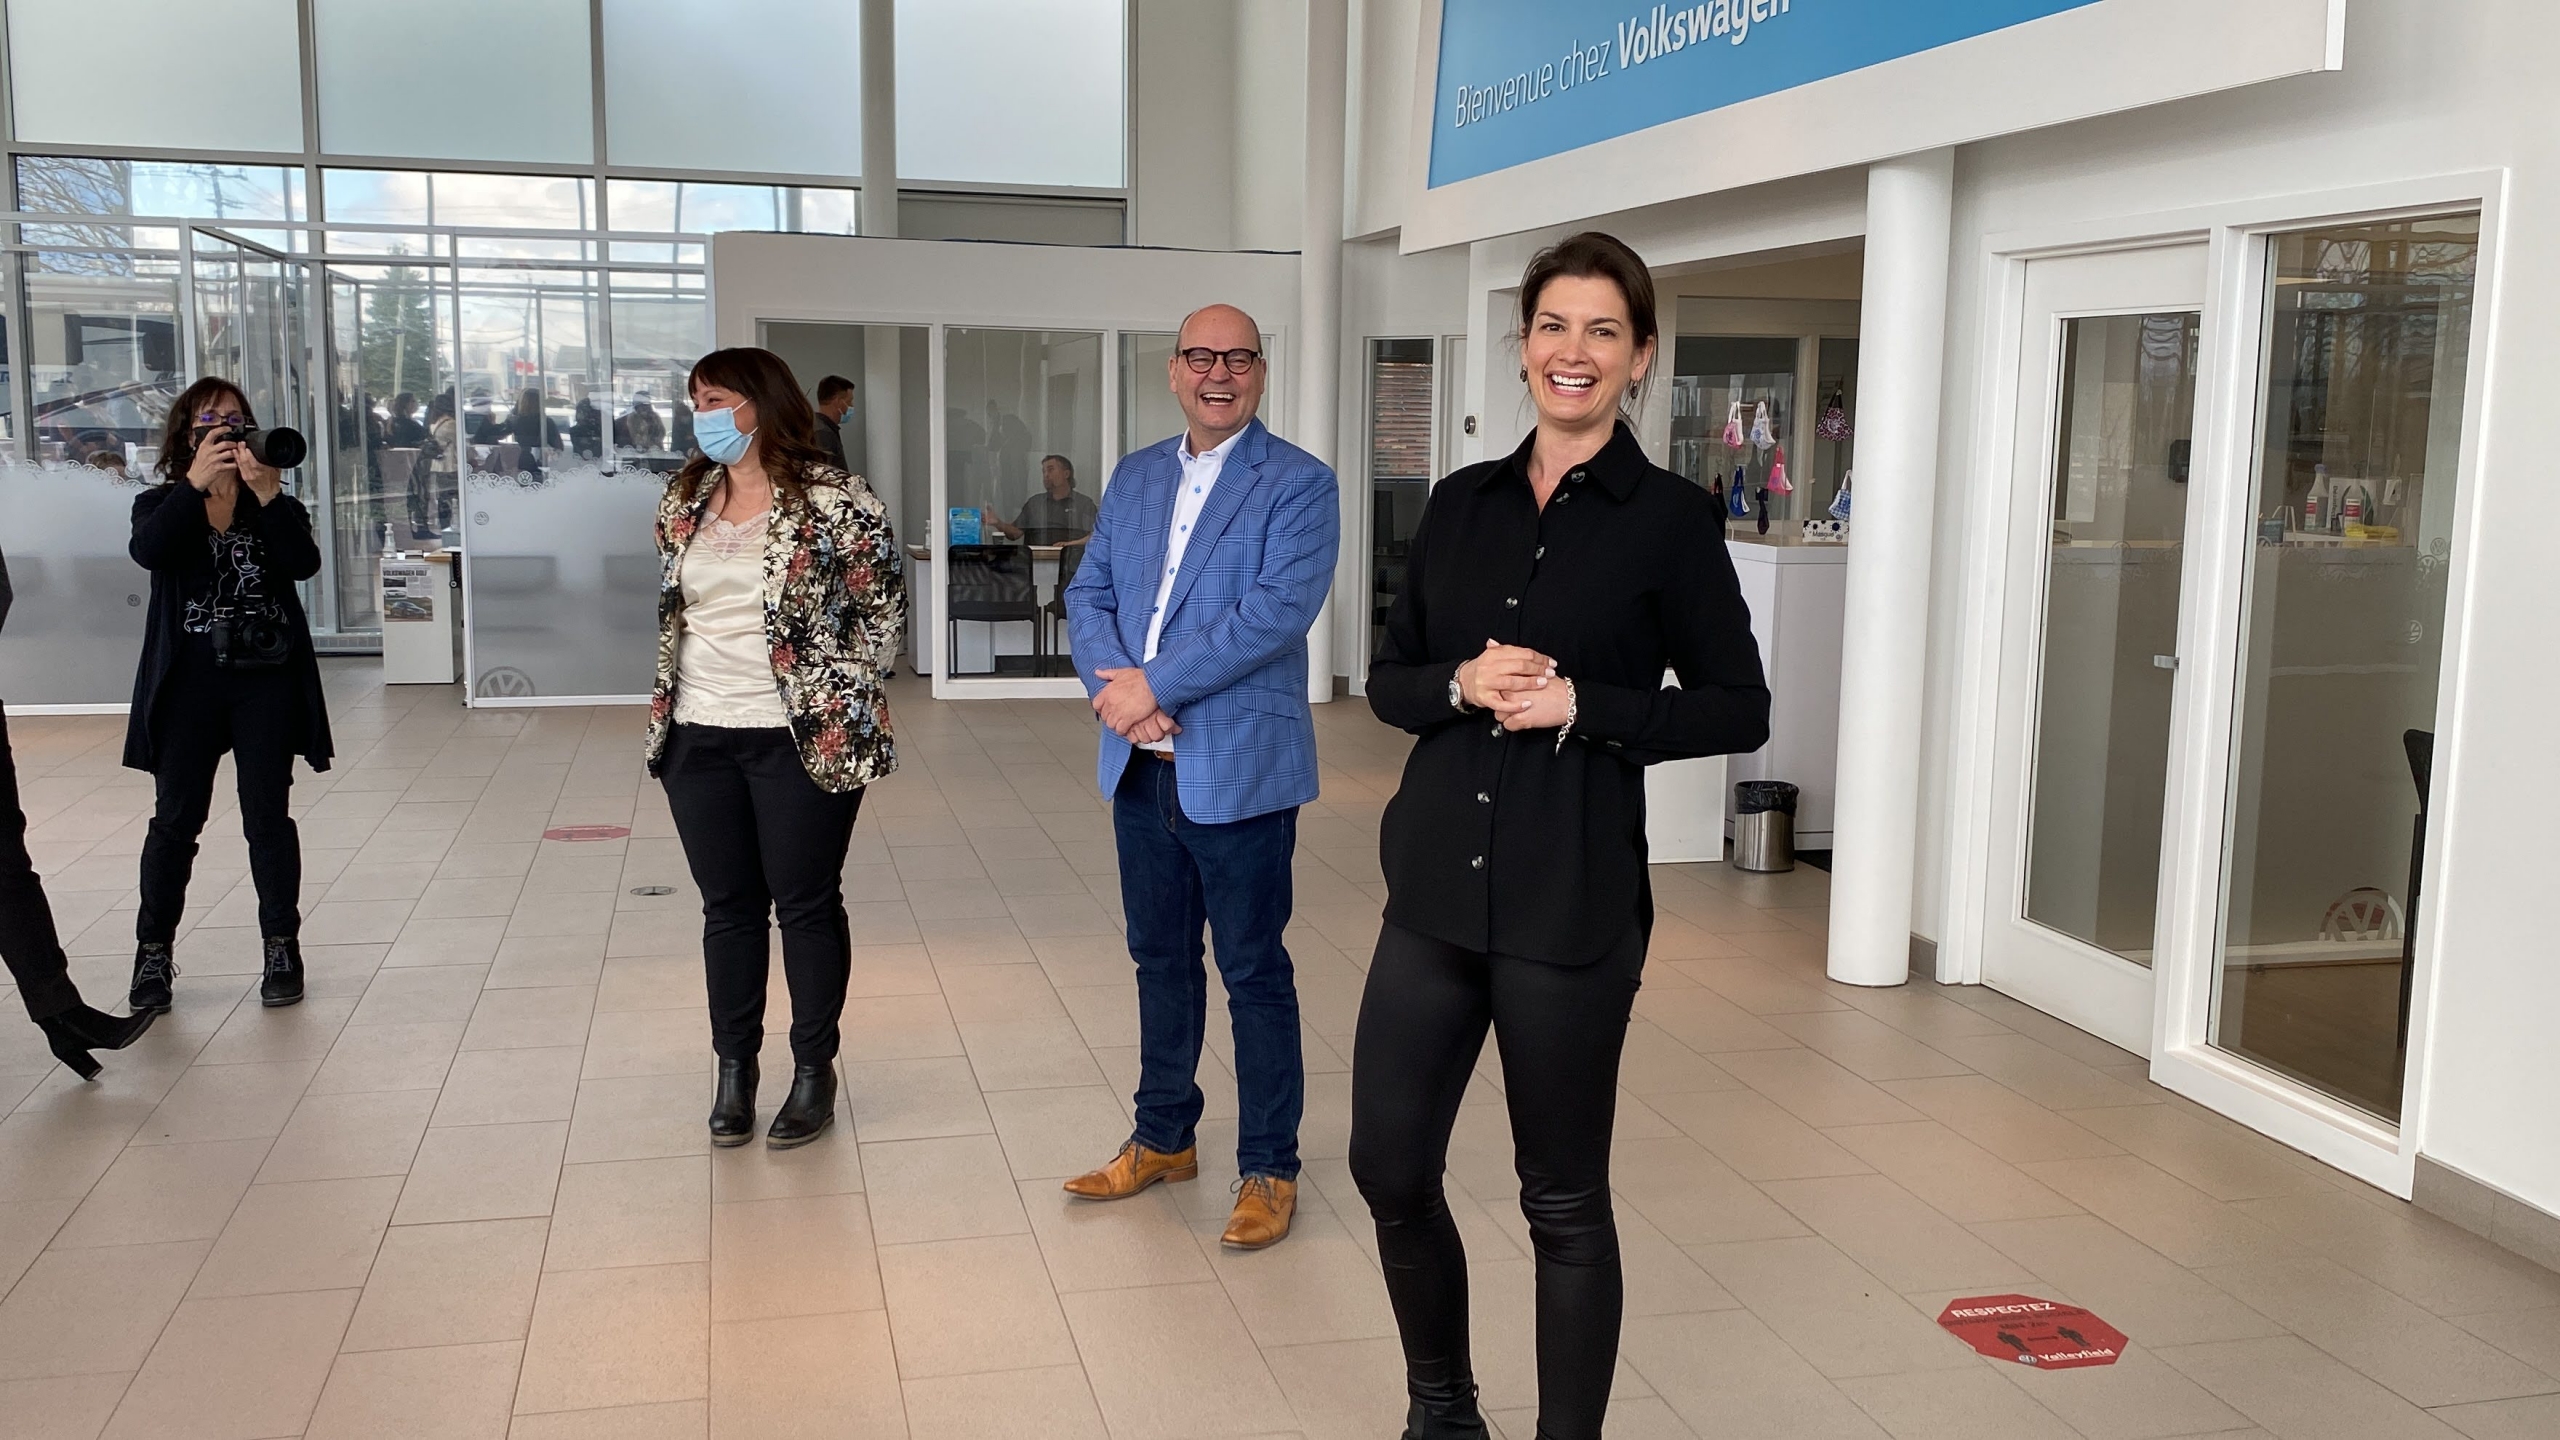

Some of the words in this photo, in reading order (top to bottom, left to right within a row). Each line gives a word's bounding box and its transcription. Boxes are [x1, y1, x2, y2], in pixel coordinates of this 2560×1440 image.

[1454, 63, 1555, 128] Bienvenue
[1559, 40, 1611, 92] chez
[1951, 1302, 2056, 1318] RESPECTEZ
[2038, 1348, 2116, 1362] Valleyfield
